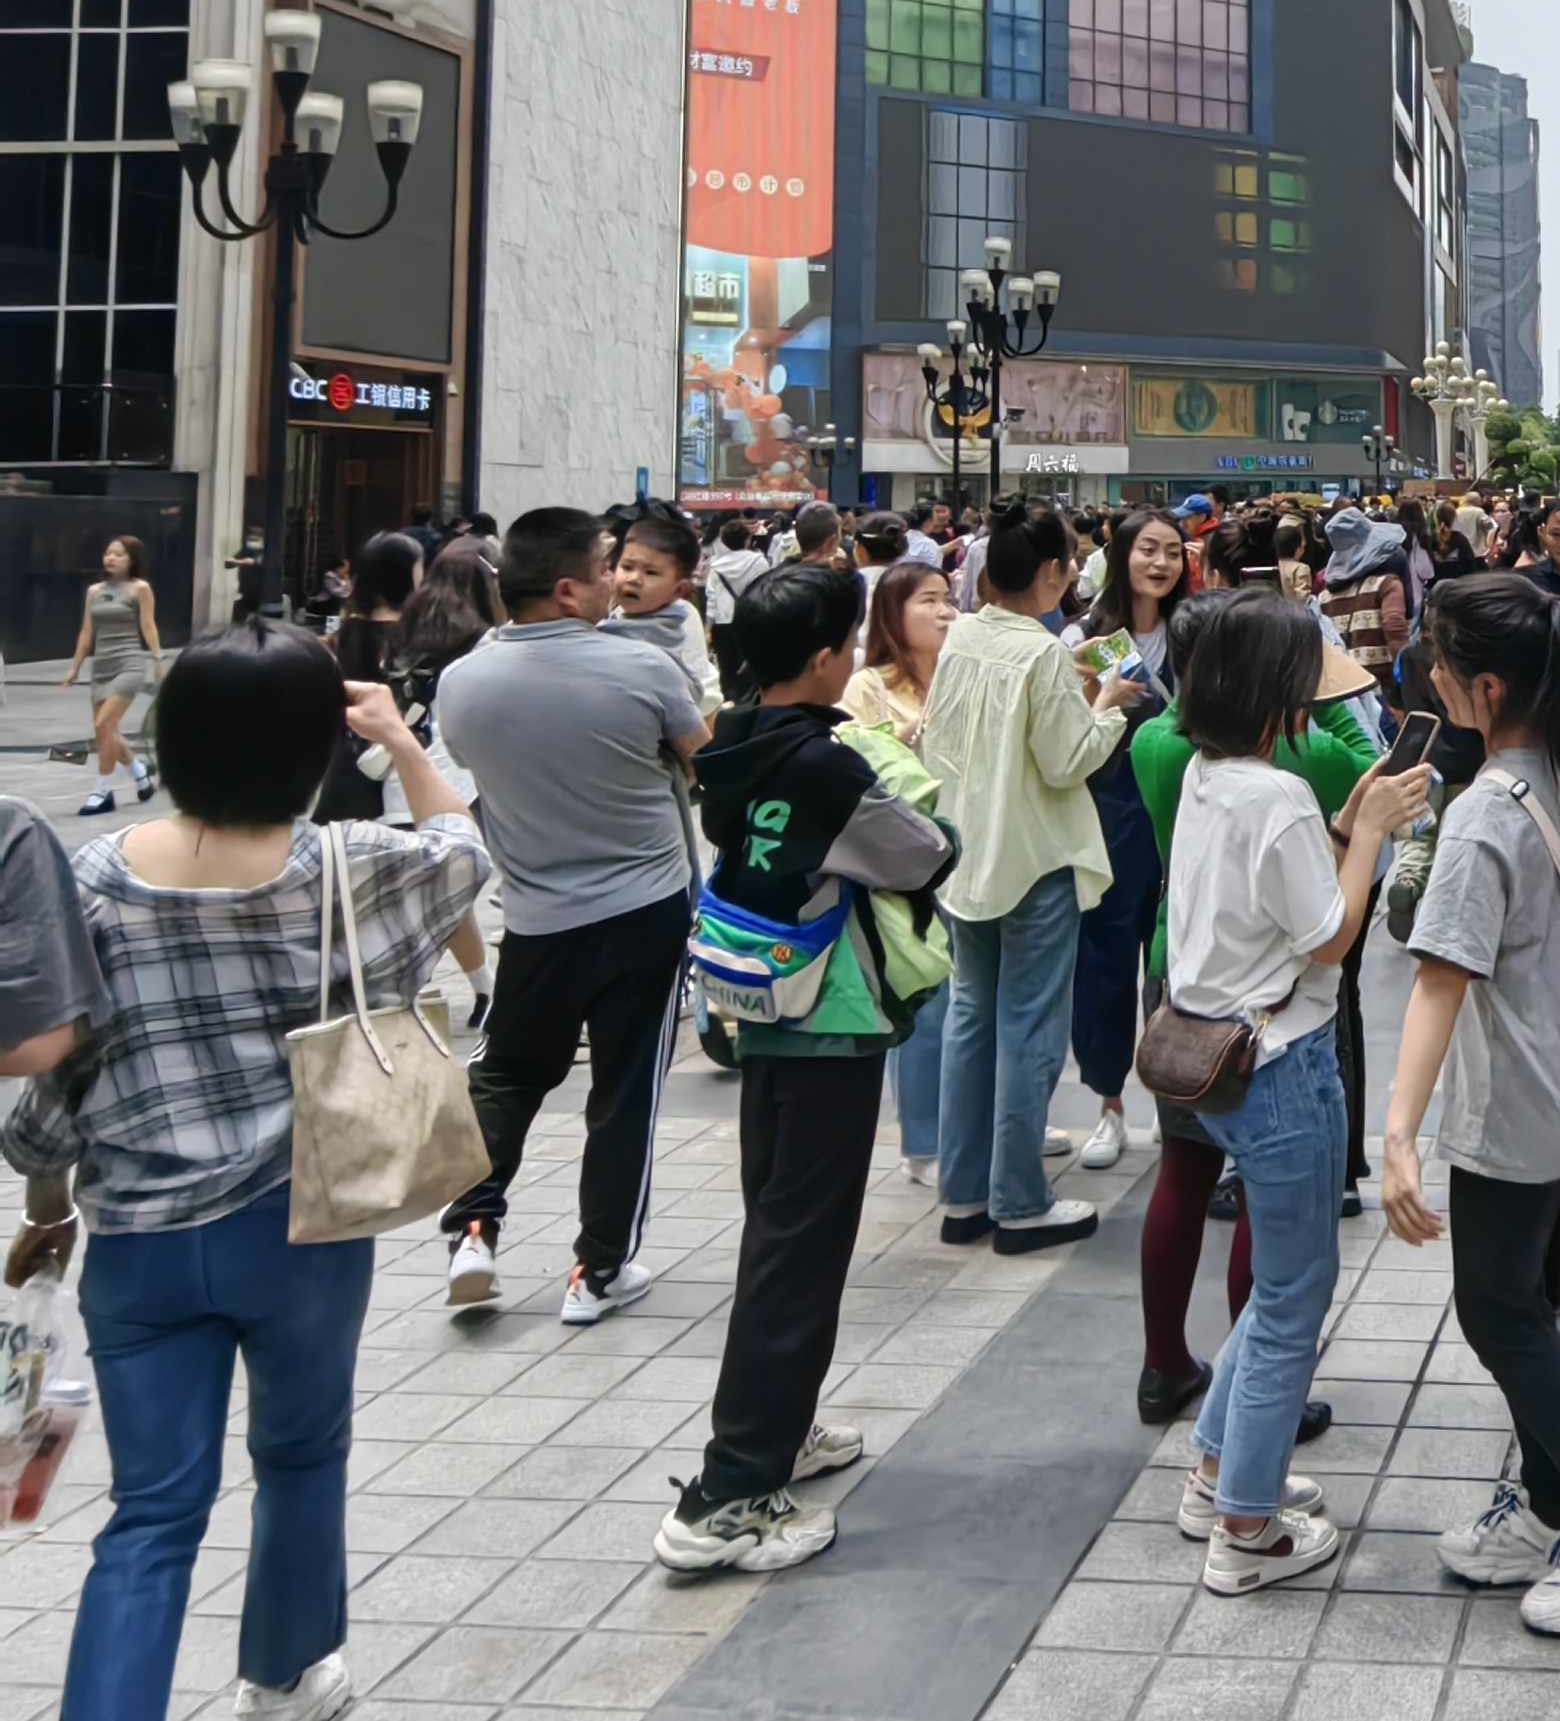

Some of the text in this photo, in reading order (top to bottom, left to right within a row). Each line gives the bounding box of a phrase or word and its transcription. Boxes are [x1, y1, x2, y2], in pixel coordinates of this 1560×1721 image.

[355, 382, 432, 411] 工银信用卡
[1025, 452, 1079, 473] 周六福
